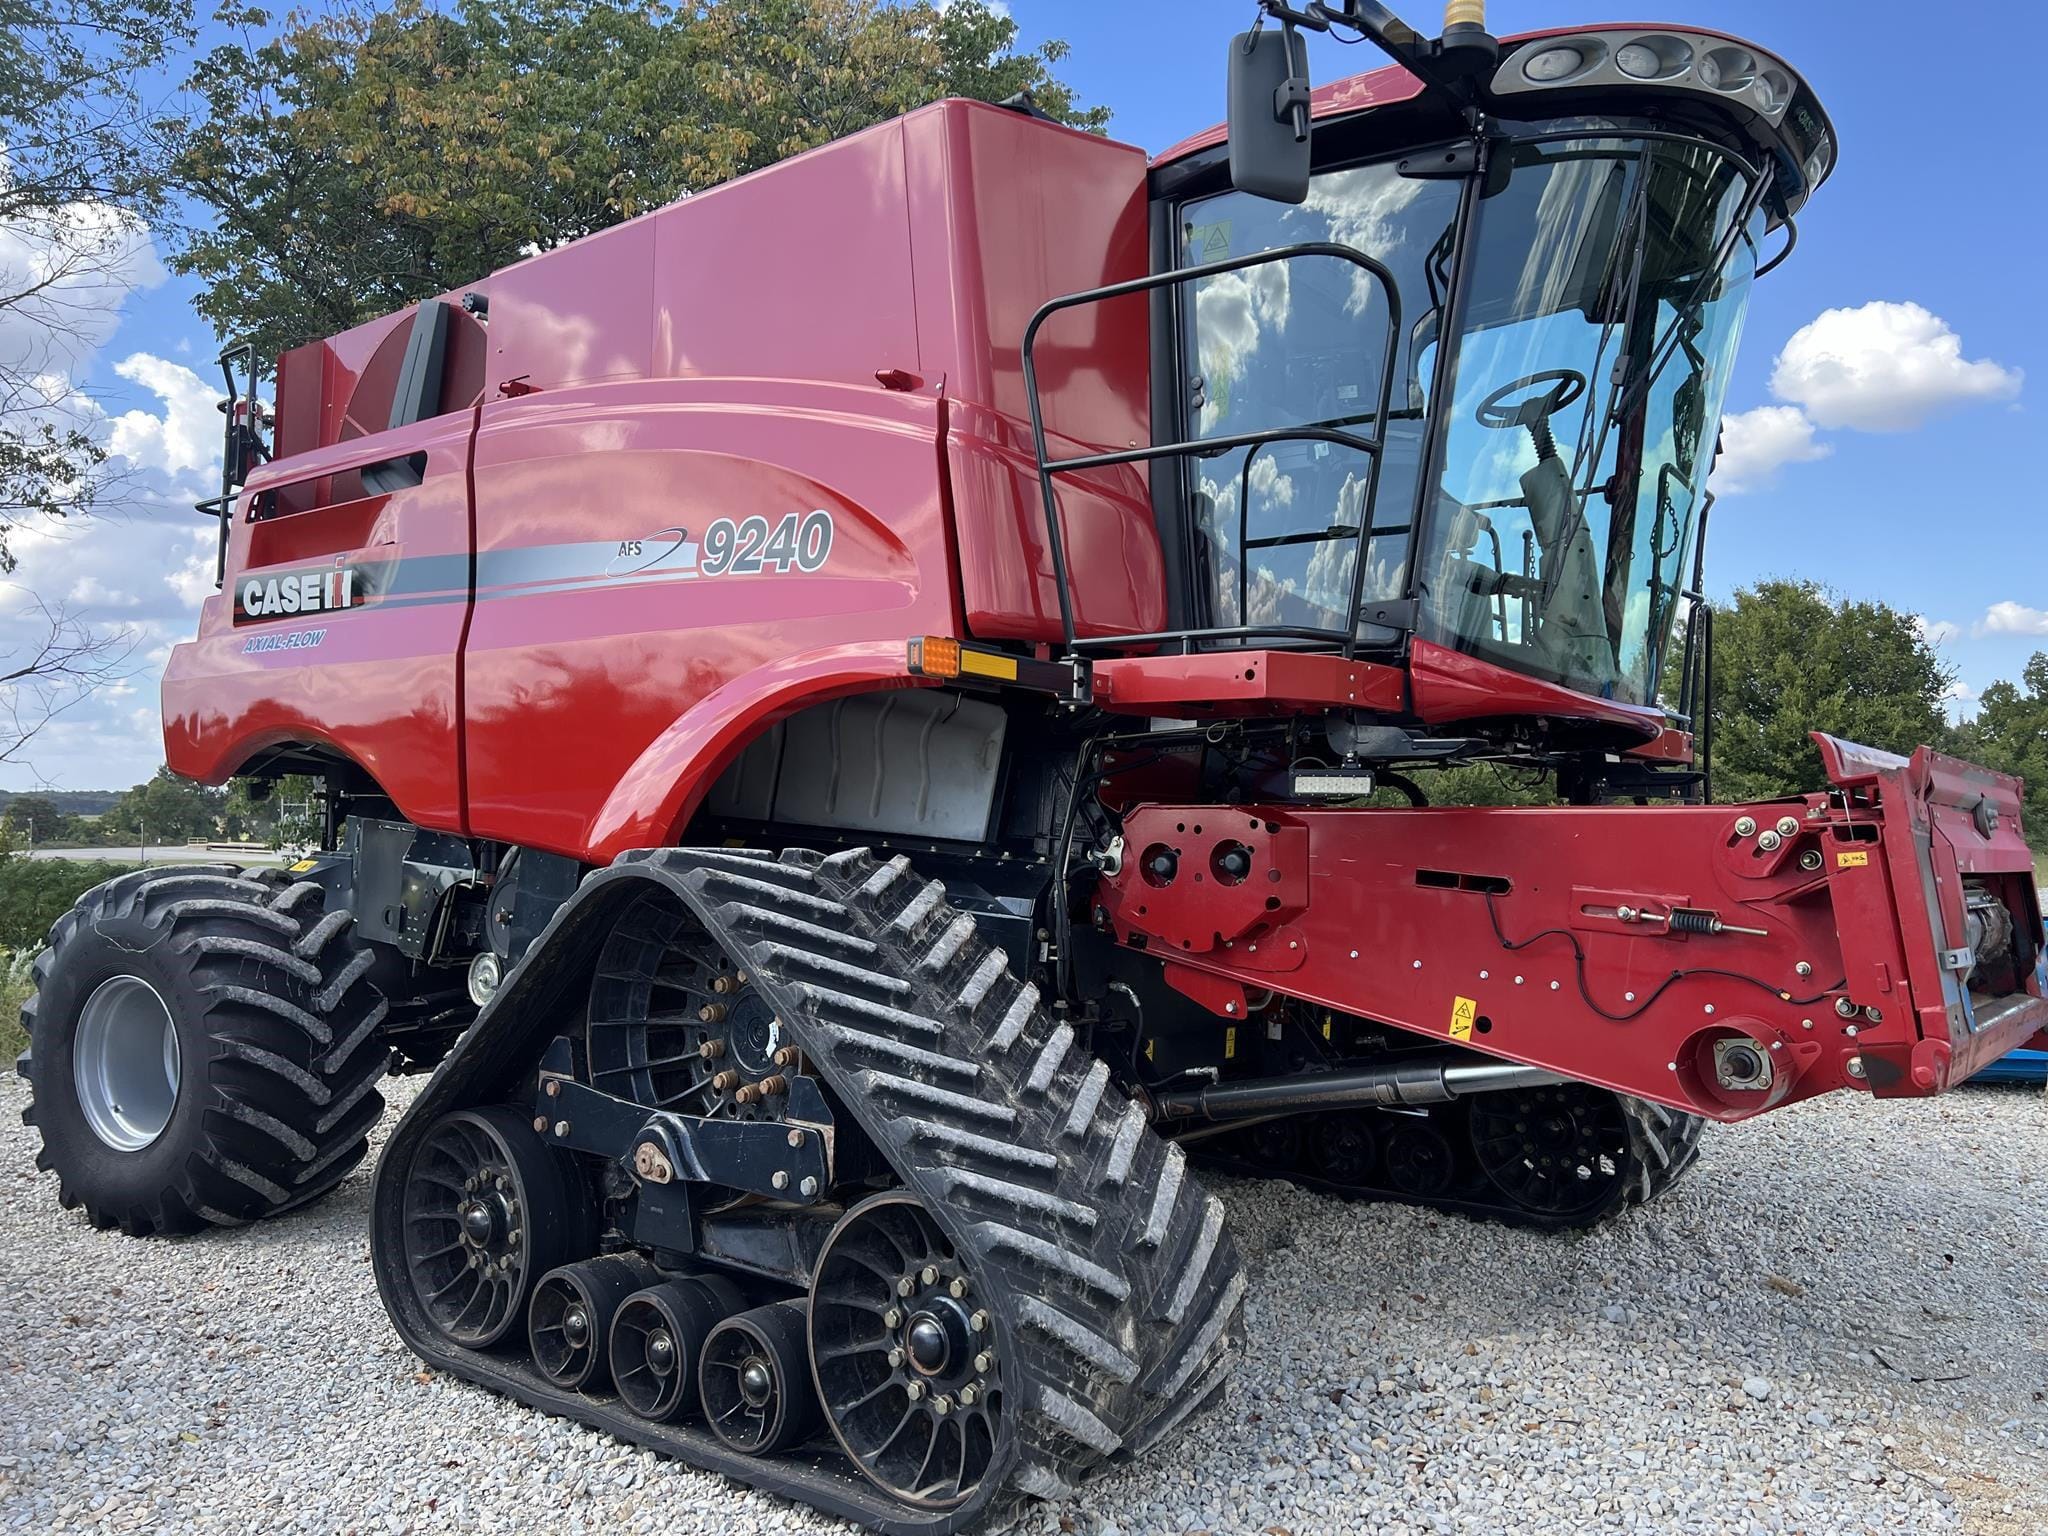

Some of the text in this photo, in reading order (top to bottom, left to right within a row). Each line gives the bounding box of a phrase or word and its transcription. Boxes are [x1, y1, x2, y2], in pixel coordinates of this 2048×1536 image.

[618, 540, 642, 557] AFS
[701, 509, 834, 577] 9240
[243, 574, 321, 617] CASE
[241, 628, 327, 655] AXIAL-FLOW
